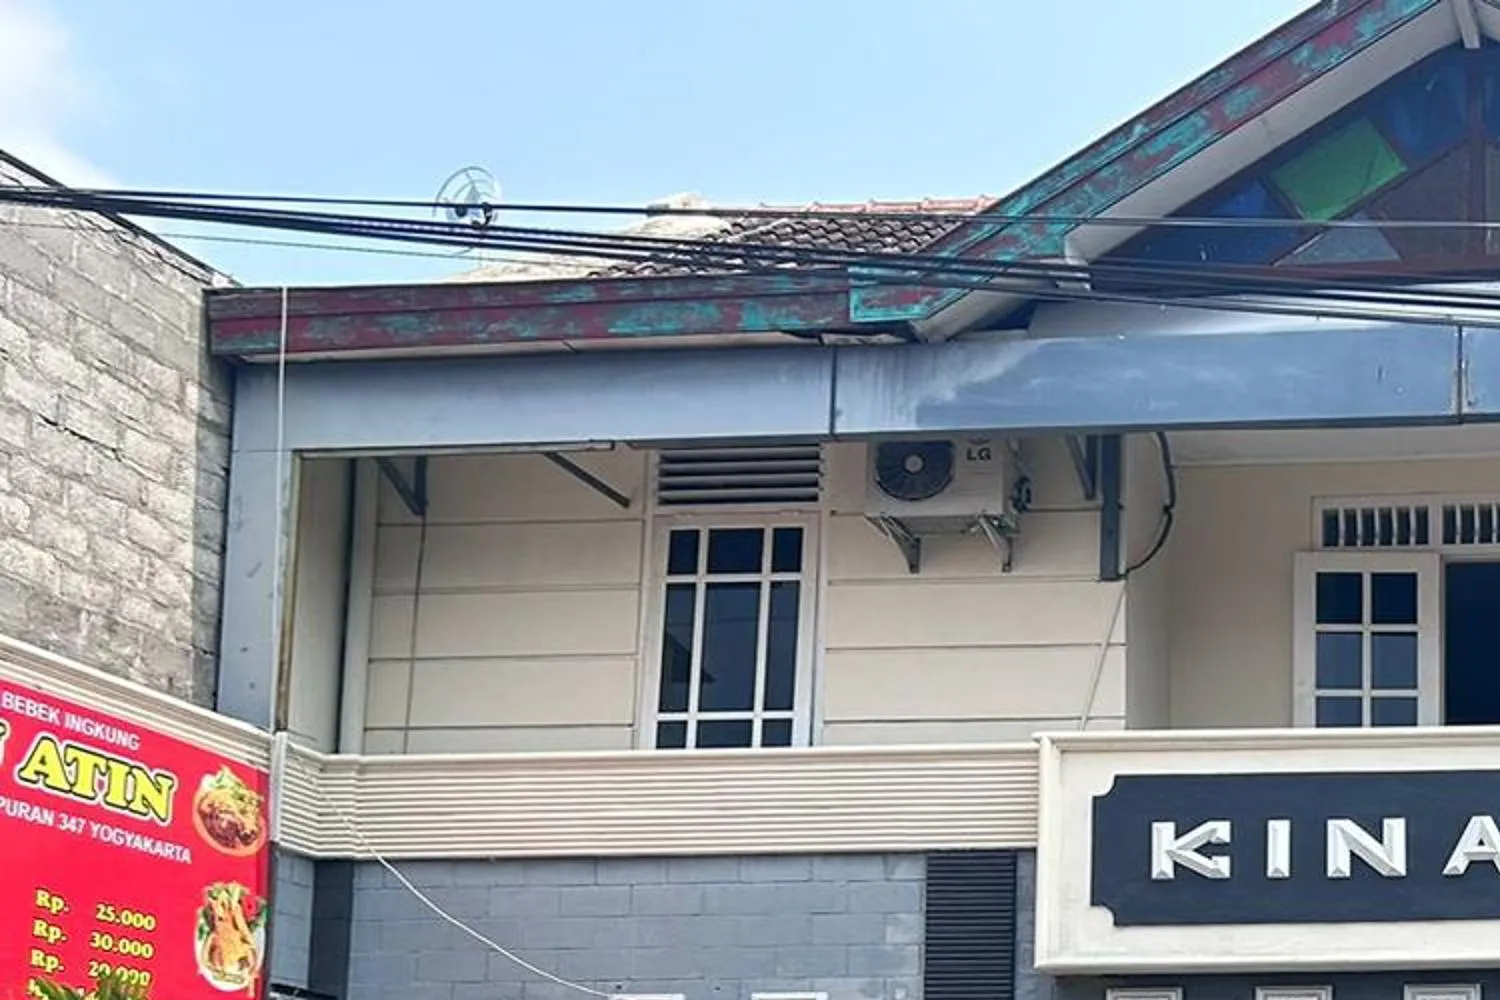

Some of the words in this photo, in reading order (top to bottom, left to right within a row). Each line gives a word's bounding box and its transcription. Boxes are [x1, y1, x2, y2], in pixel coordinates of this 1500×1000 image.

[966, 447, 991, 461] LG
[1, 692, 61, 726] BEBEK
[64, 711, 140, 751] INGKUNG
[17, 734, 175, 823] ATIN
[58, 812, 87, 834] 347
[89, 821, 193, 864] YOGYAKARTA
[35, 887, 70, 915] Rp.
[94, 902, 157, 931] 25.000
[29, 947, 65, 973] Rp.
[32, 918, 68, 944] Rp.
[89, 931, 154, 959] 30.000
